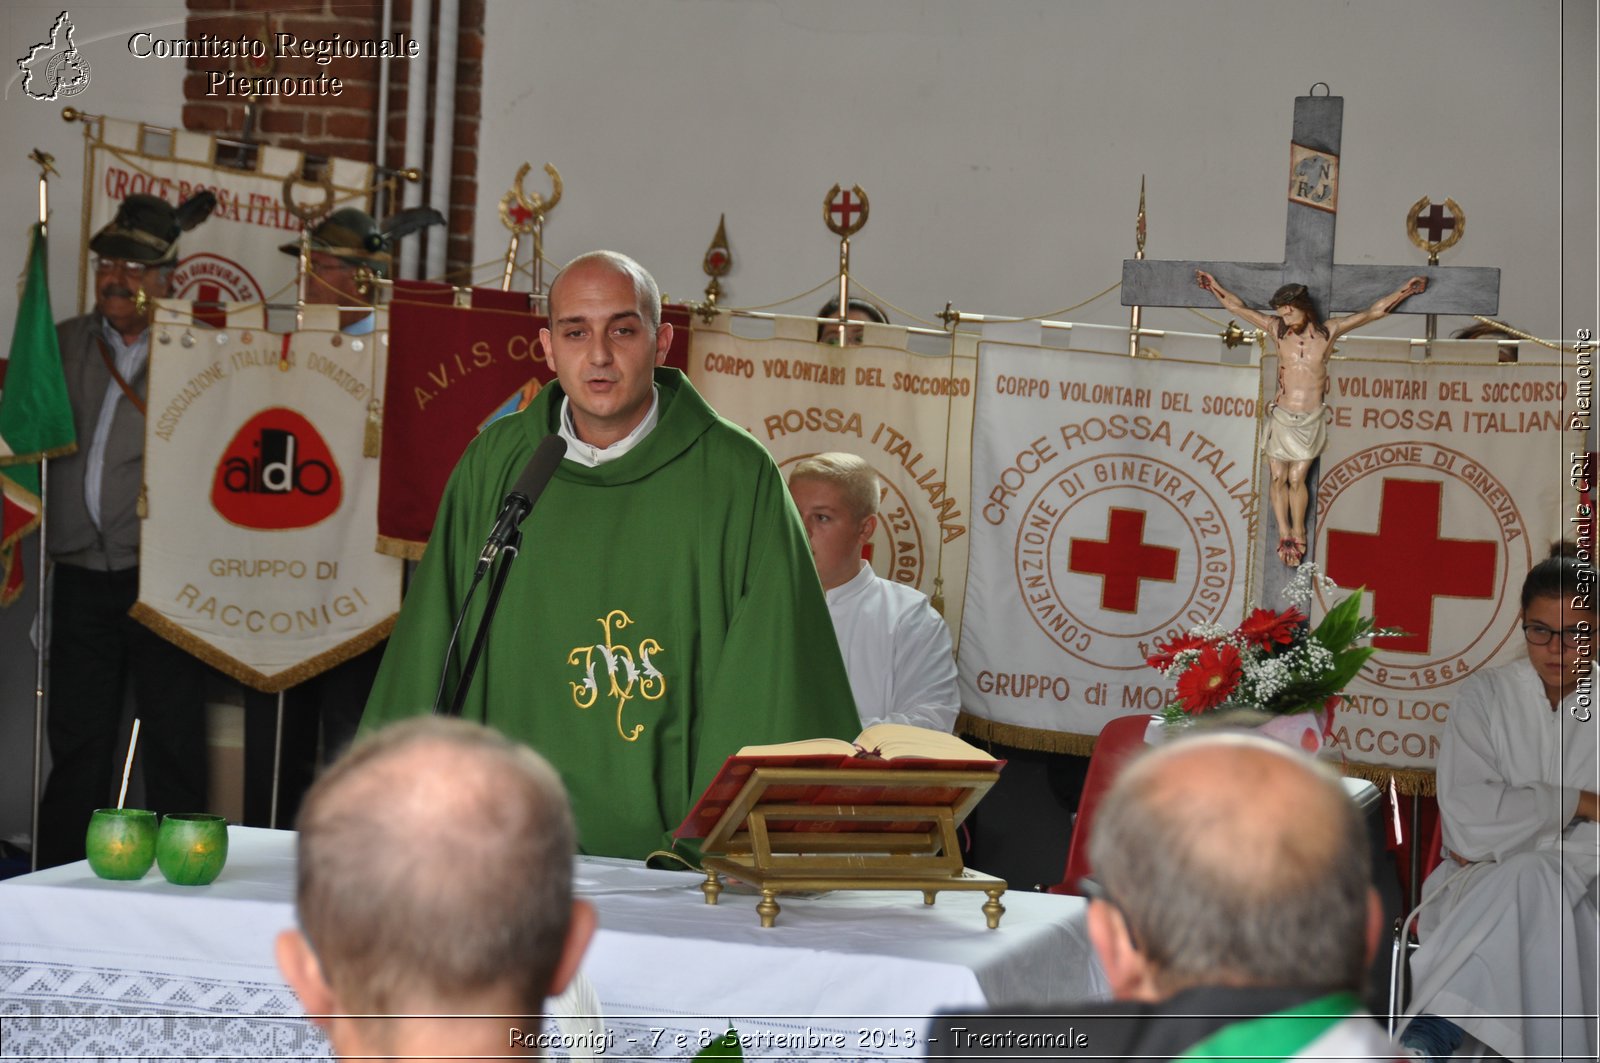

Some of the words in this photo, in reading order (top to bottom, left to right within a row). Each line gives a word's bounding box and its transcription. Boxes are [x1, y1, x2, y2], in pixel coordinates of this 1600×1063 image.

[174, 270, 190, 287] DI
[191, 264, 241, 287] GINEVRA
[155, 360, 227, 443] ASSOCIAZIONE
[231, 349, 297, 371] ITALIAA
[307, 351, 370, 402] DONATORI
[414, 341, 497, 411] A.V.I.S.
[704, 353, 754, 379] CORPO
[762, 360, 846, 386] VOLONTARI
[855, 368, 885, 388] DEL
[893, 372, 970, 398] SOCCORSO
[996, 375, 1049, 399] CORPO
[1060, 382, 1151, 409] VOLONTARI
[1161, 391, 1193, 413] DEL
[1338, 377, 1427, 400] VOLONTARI
[1439, 381, 1472, 402] DEL
[1481, 381, 1567, 403] SOCCORSO
[1363, 407, 1453, 432] ROSSA
[1463, 410, 1584, 434] ITALIANA
[223, 430, 332, 496] aido
[764, 407, 863, 441] ROSSA
[871, 423, 967, 545] ITALIANA
[982, 436, 1058, 527] CROCE
[1060, 414, 1173, 450] ROSSA
[1058, 473, 1085, 498] DI
[1094, 461, 1196, 508] GINEVRA
[888, 506, 911, 534] 22
[1433, 451, 1456, 470] DI
[1460, 463, 1522, 543] GINEVRA
[1194, 510, 1221, 539] 22
[208, 558, 306, 579] GRUPPO
[316, 560, 338, 580] DI
[1023, 500, 1092, 652] CONVENZIONE
[1187, 546, 1228, 626] AGOSTO
[175, 583, 369, 634] RACCONIGI
[976, 670, 1070, 701] GRUPPO
[1084, 682, 1107, 706] di
